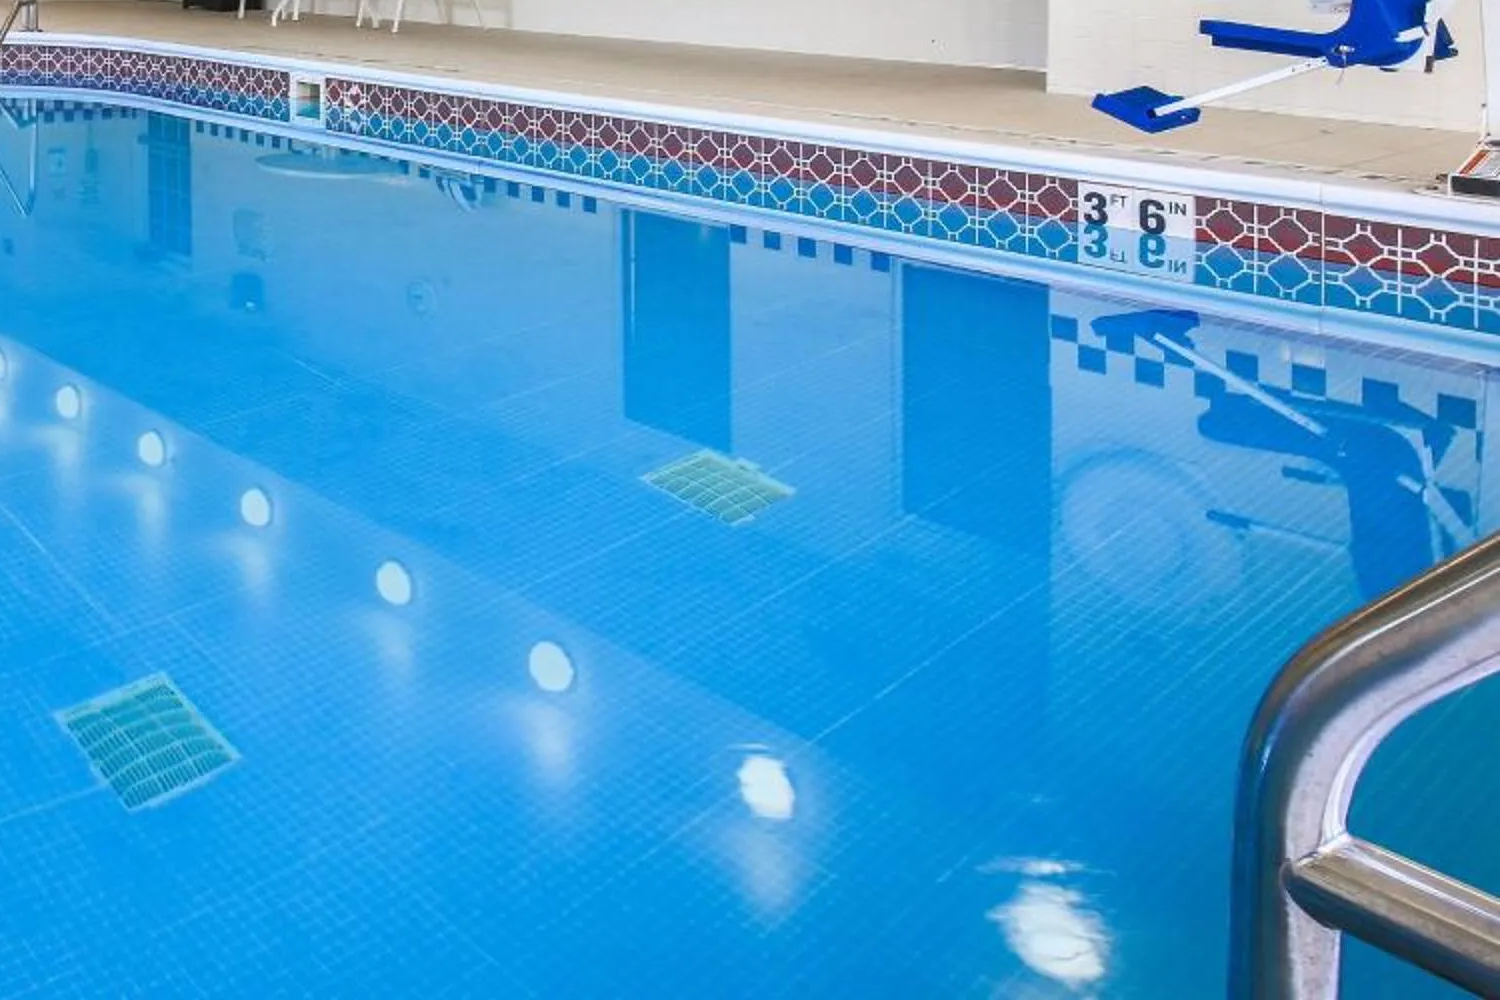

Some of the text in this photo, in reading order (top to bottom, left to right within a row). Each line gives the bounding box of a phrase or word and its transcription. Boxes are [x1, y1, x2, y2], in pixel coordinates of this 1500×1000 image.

[1083, 192, 1187, 235] 3 FT 6 IN
